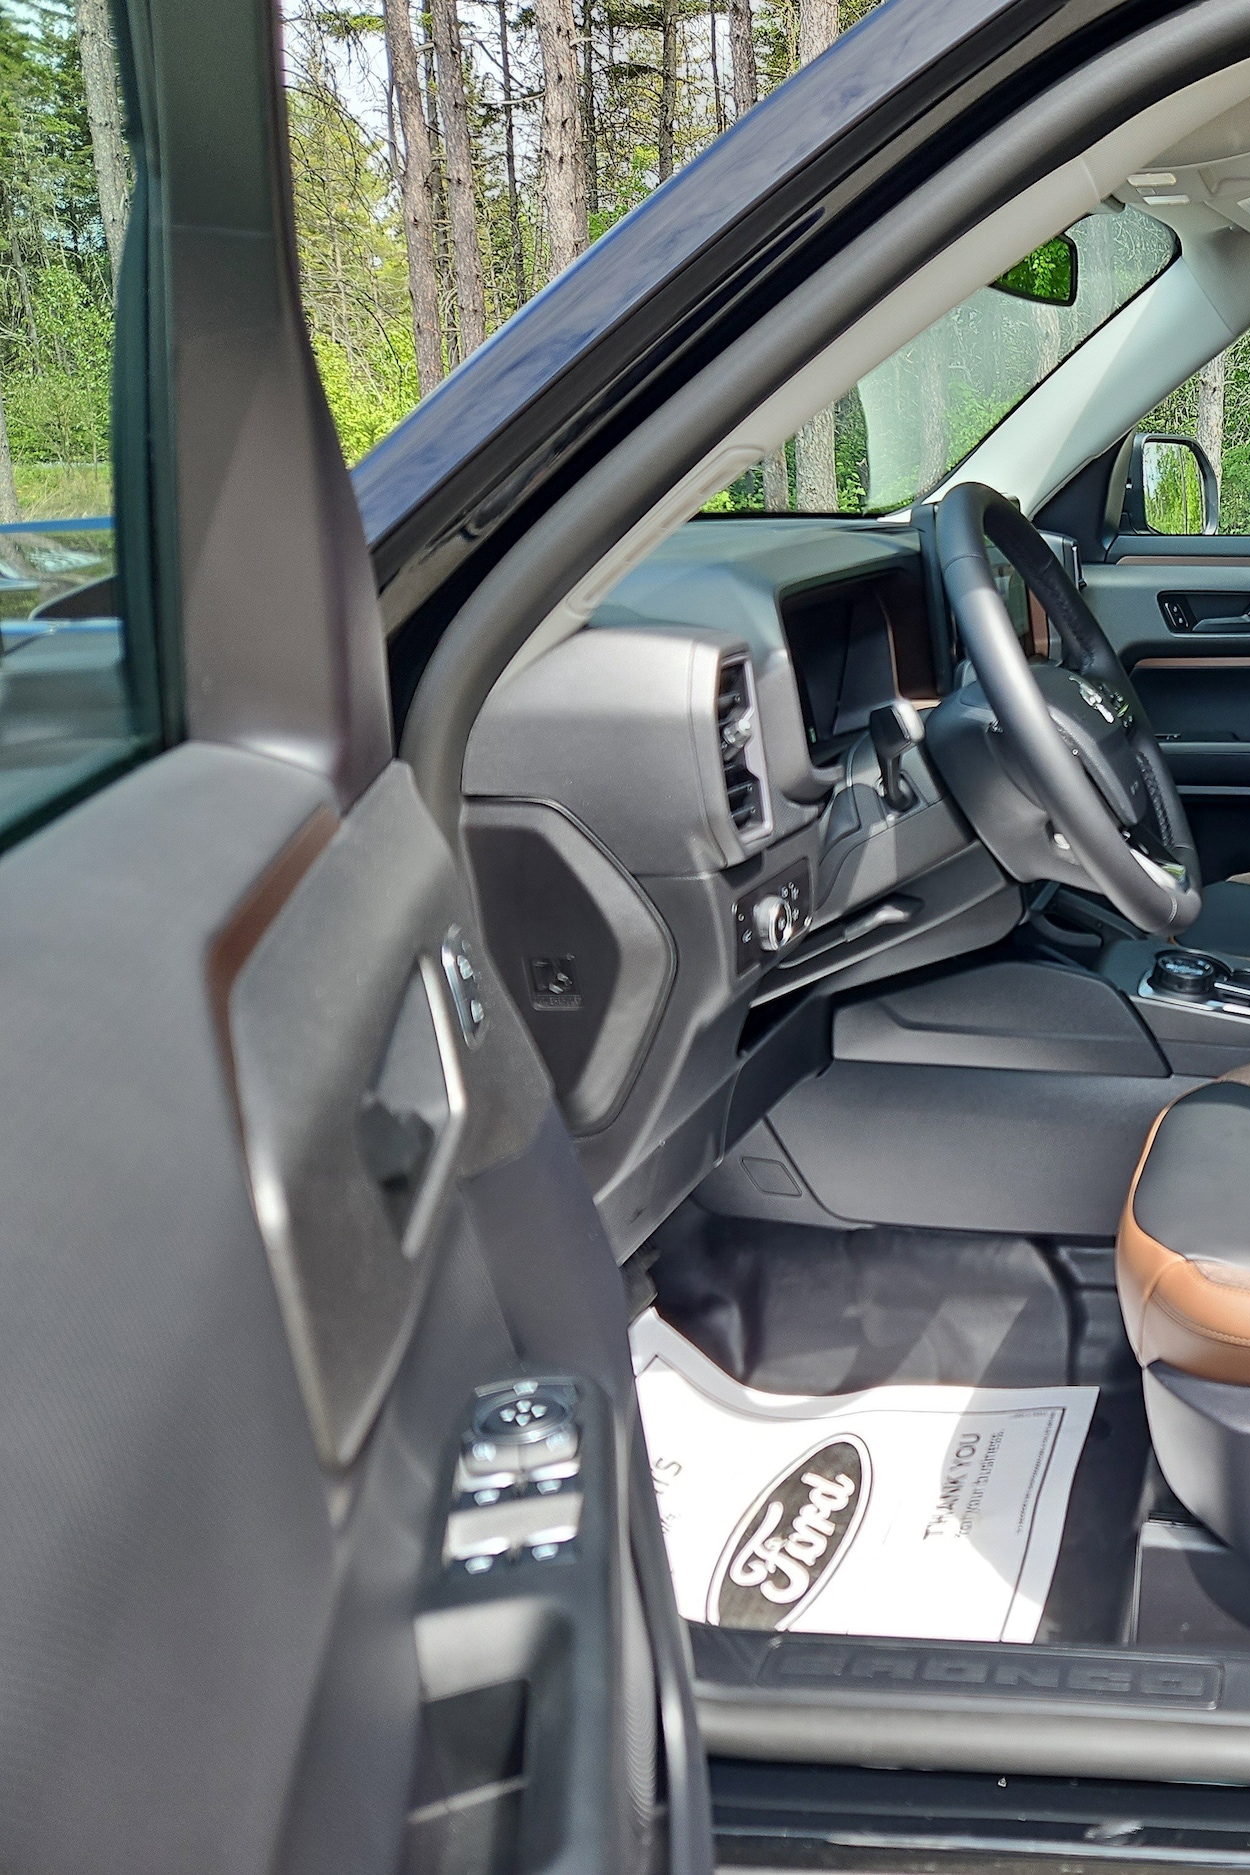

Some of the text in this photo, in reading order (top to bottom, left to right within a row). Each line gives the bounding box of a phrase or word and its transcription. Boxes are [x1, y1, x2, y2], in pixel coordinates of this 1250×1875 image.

[729, 1472, 855, 1604] Ford
[922, 1433, 980, 1541] THANK YOU
